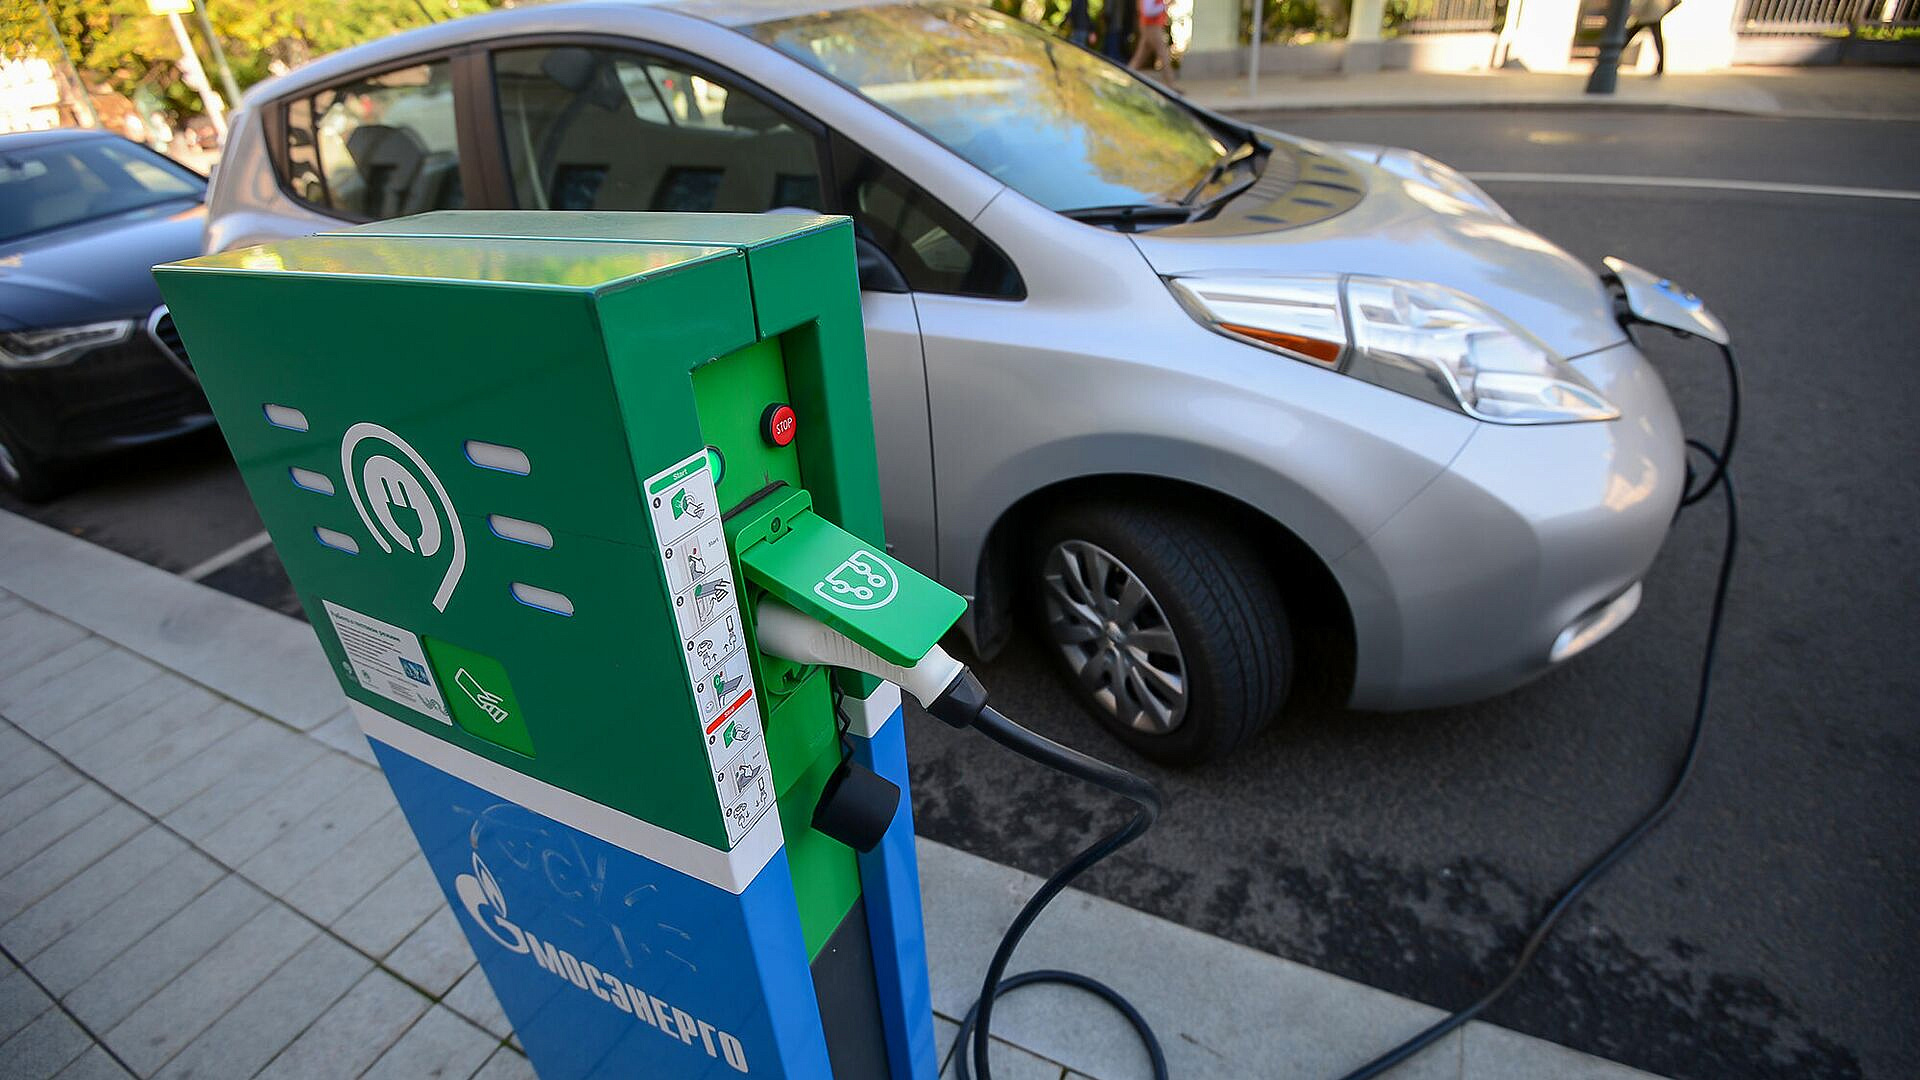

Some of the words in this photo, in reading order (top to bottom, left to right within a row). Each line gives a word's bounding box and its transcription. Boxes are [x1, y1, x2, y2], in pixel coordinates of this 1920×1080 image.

[776, 417, 793, 434] STOP
[672, 468, 688, 480] Start
[524, 930, 750, 1074] МОСЭНЕРГО
